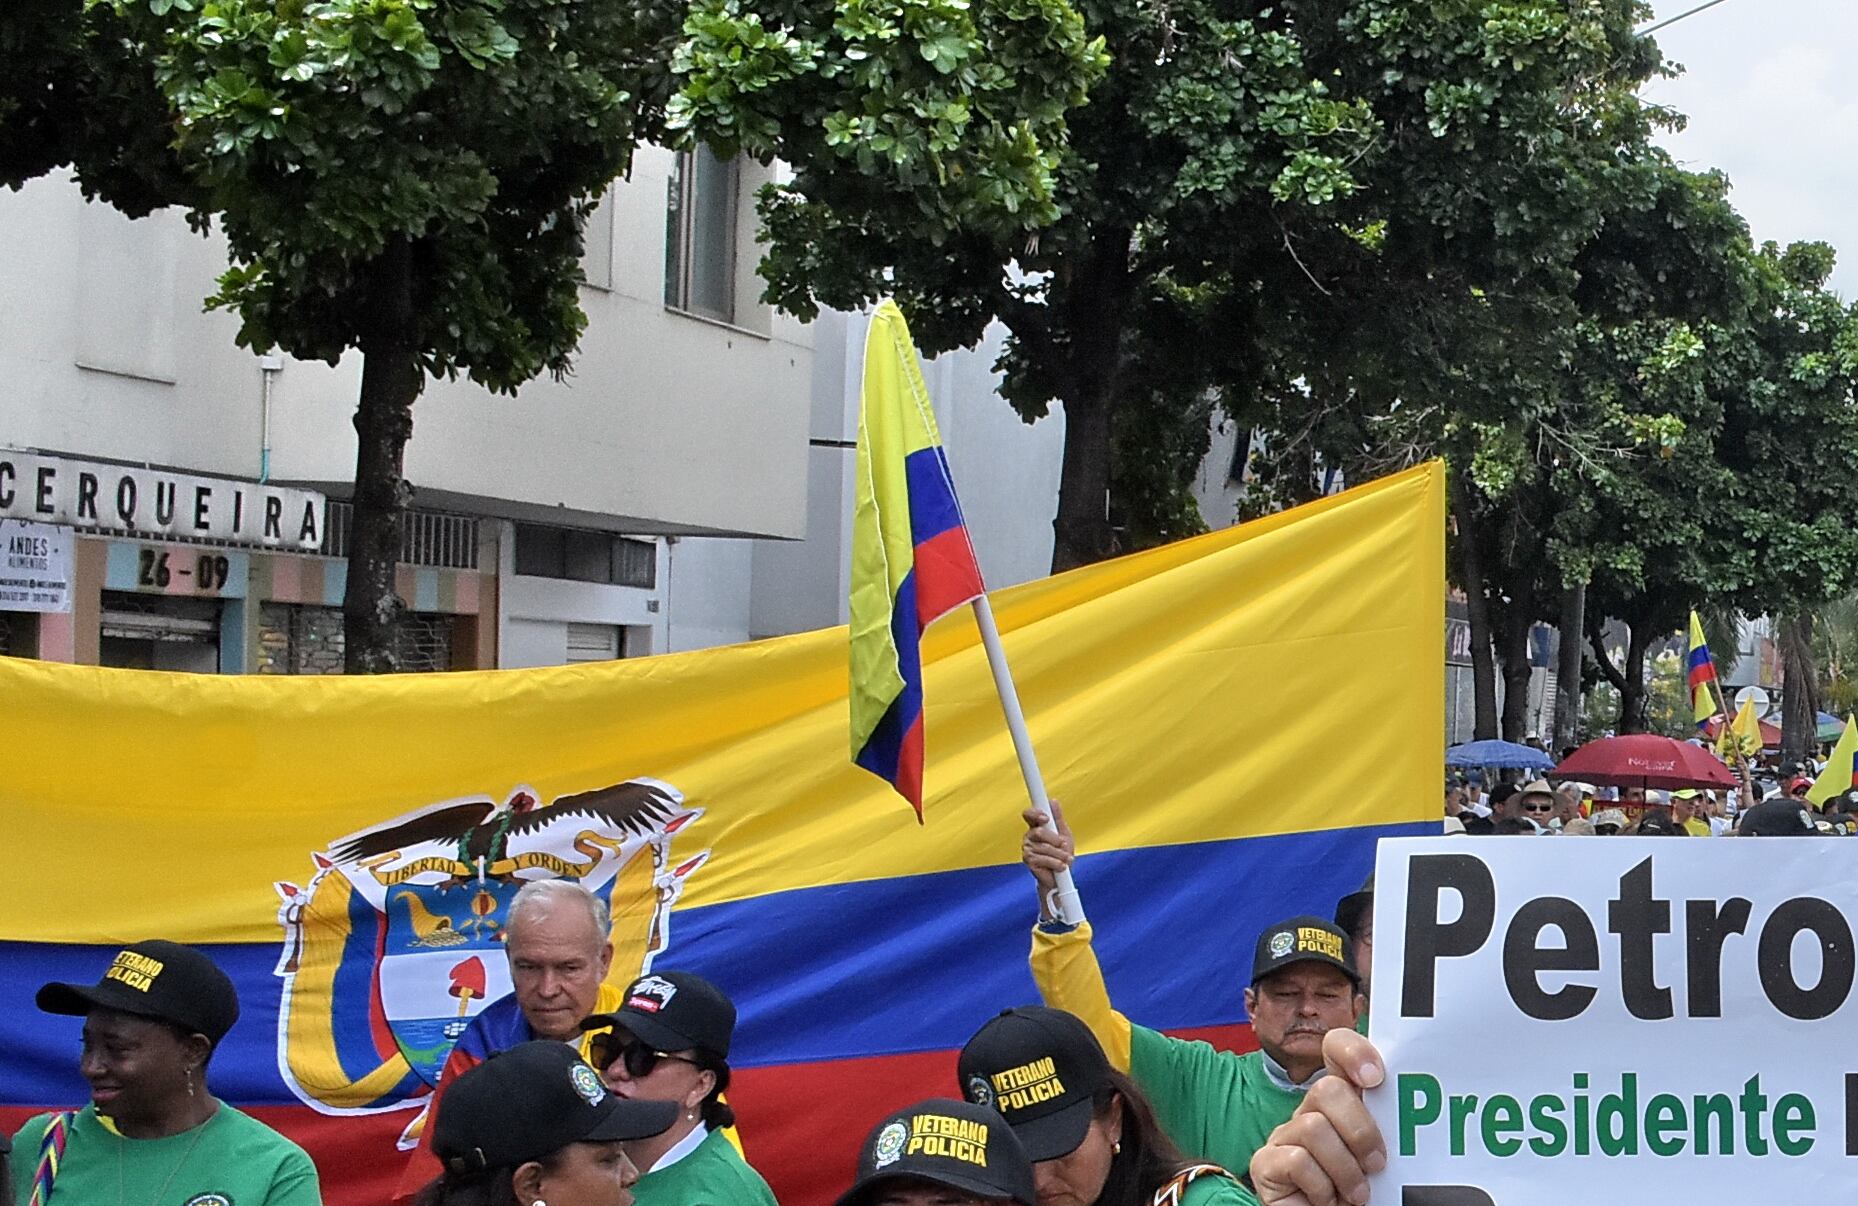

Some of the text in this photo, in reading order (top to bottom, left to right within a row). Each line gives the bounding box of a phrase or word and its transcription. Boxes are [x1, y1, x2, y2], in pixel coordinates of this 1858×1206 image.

[0, 462, 317, 542] CERQUEIRA
[9, 537, 48, 556] ANDES
[385, 856, 456, 886] LIBERTAD
[513, 852, 583, 877] Y ORDEN
[1297, 927, 1343, 949] VETERANO
[1298, 940, 1345, 962] POLICIA
[1400, 853, 1857, 1021] Petro
[113, 951, 164, 977] ETERANO
[106, 966, 152, 993] OLICIA
[991, 1056, 1057, 1093] VETERANO
[997, 1077, 1066, 1112] POLICIA
[912, 1114, 989, 1144] VETERANO
[1397, 1071, 1818, 1158] Presidente
[907, 1136, 988, 1168] POLICIA
